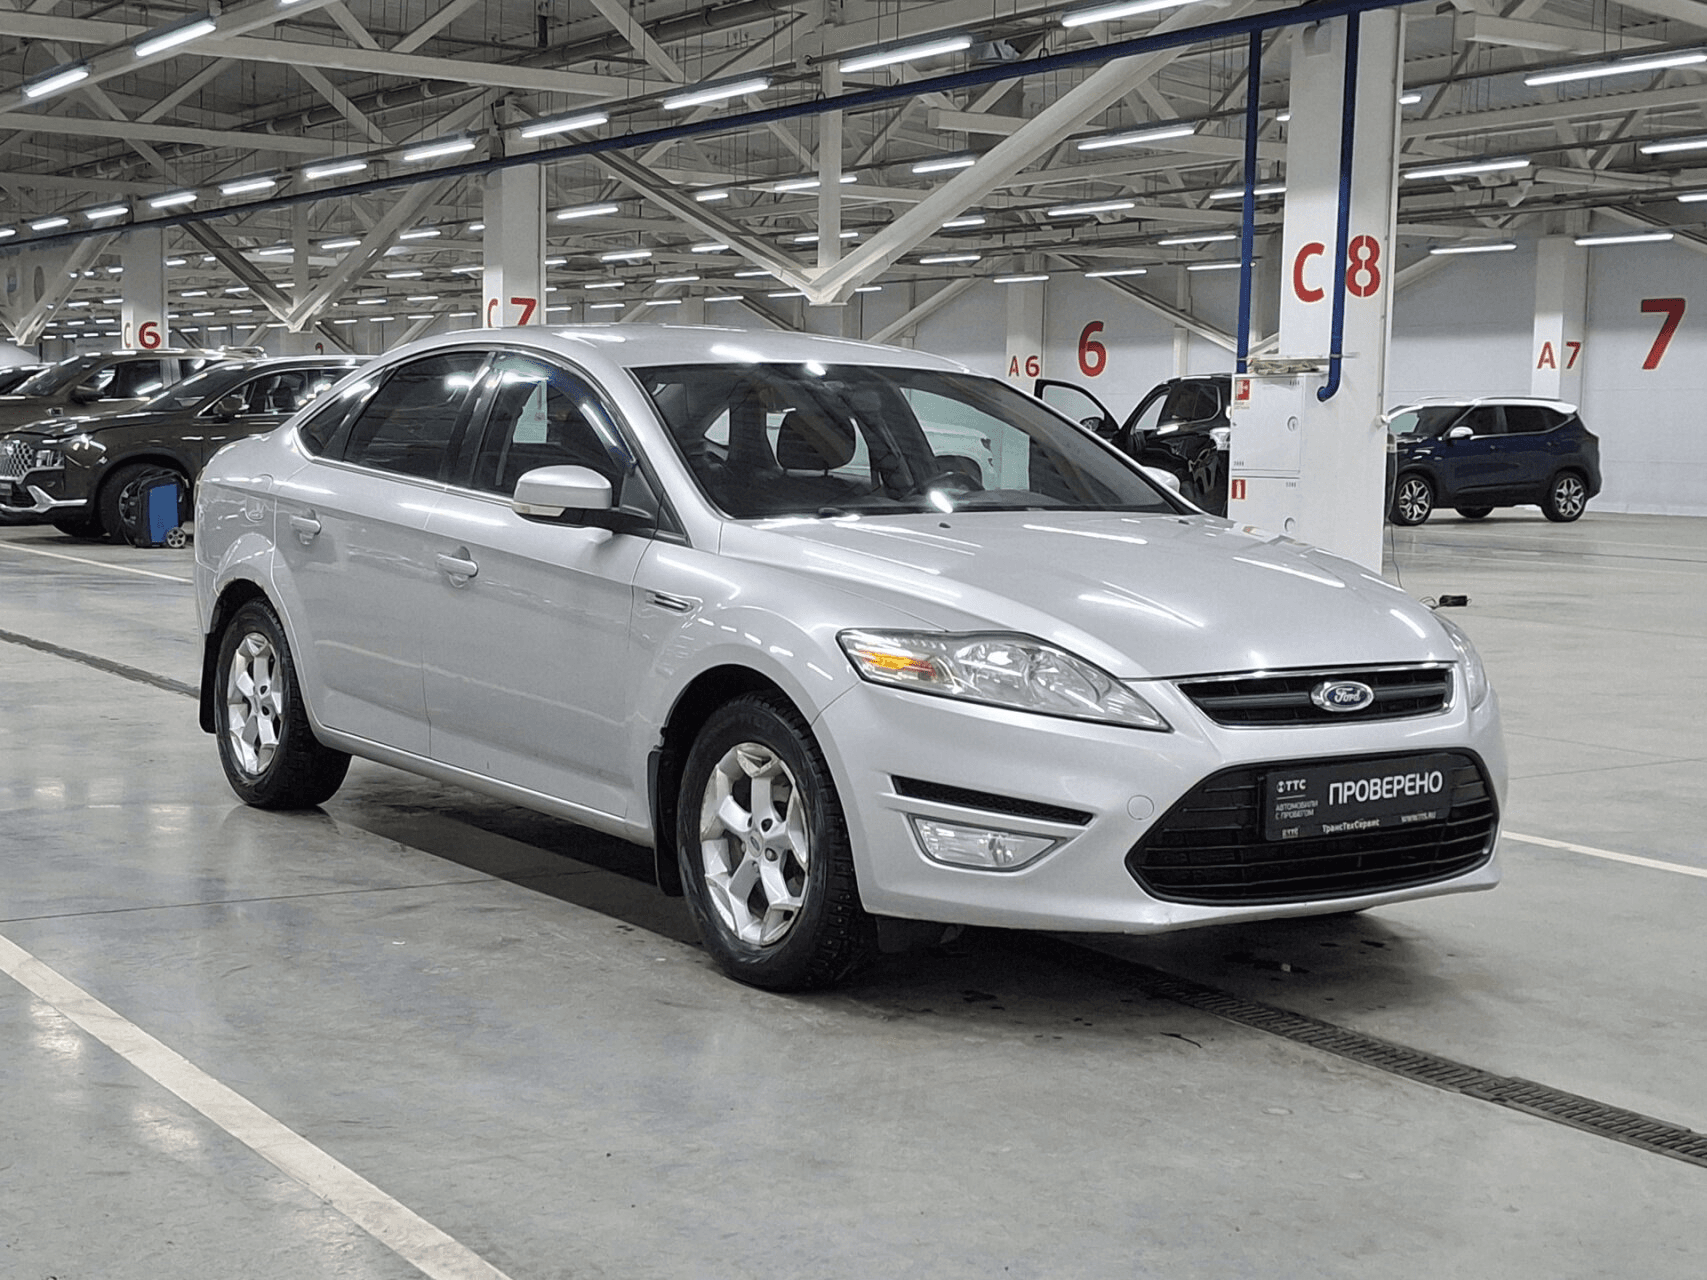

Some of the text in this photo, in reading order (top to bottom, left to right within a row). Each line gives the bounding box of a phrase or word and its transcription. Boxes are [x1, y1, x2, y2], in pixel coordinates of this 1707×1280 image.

[1078, 320, 1107, 377] 6
[1641, 298, 1686, 370] 7
[1334, 687, 1361, 703] Ford
[1329, 771, 1444, 806] ПРОВЕРЕНО
